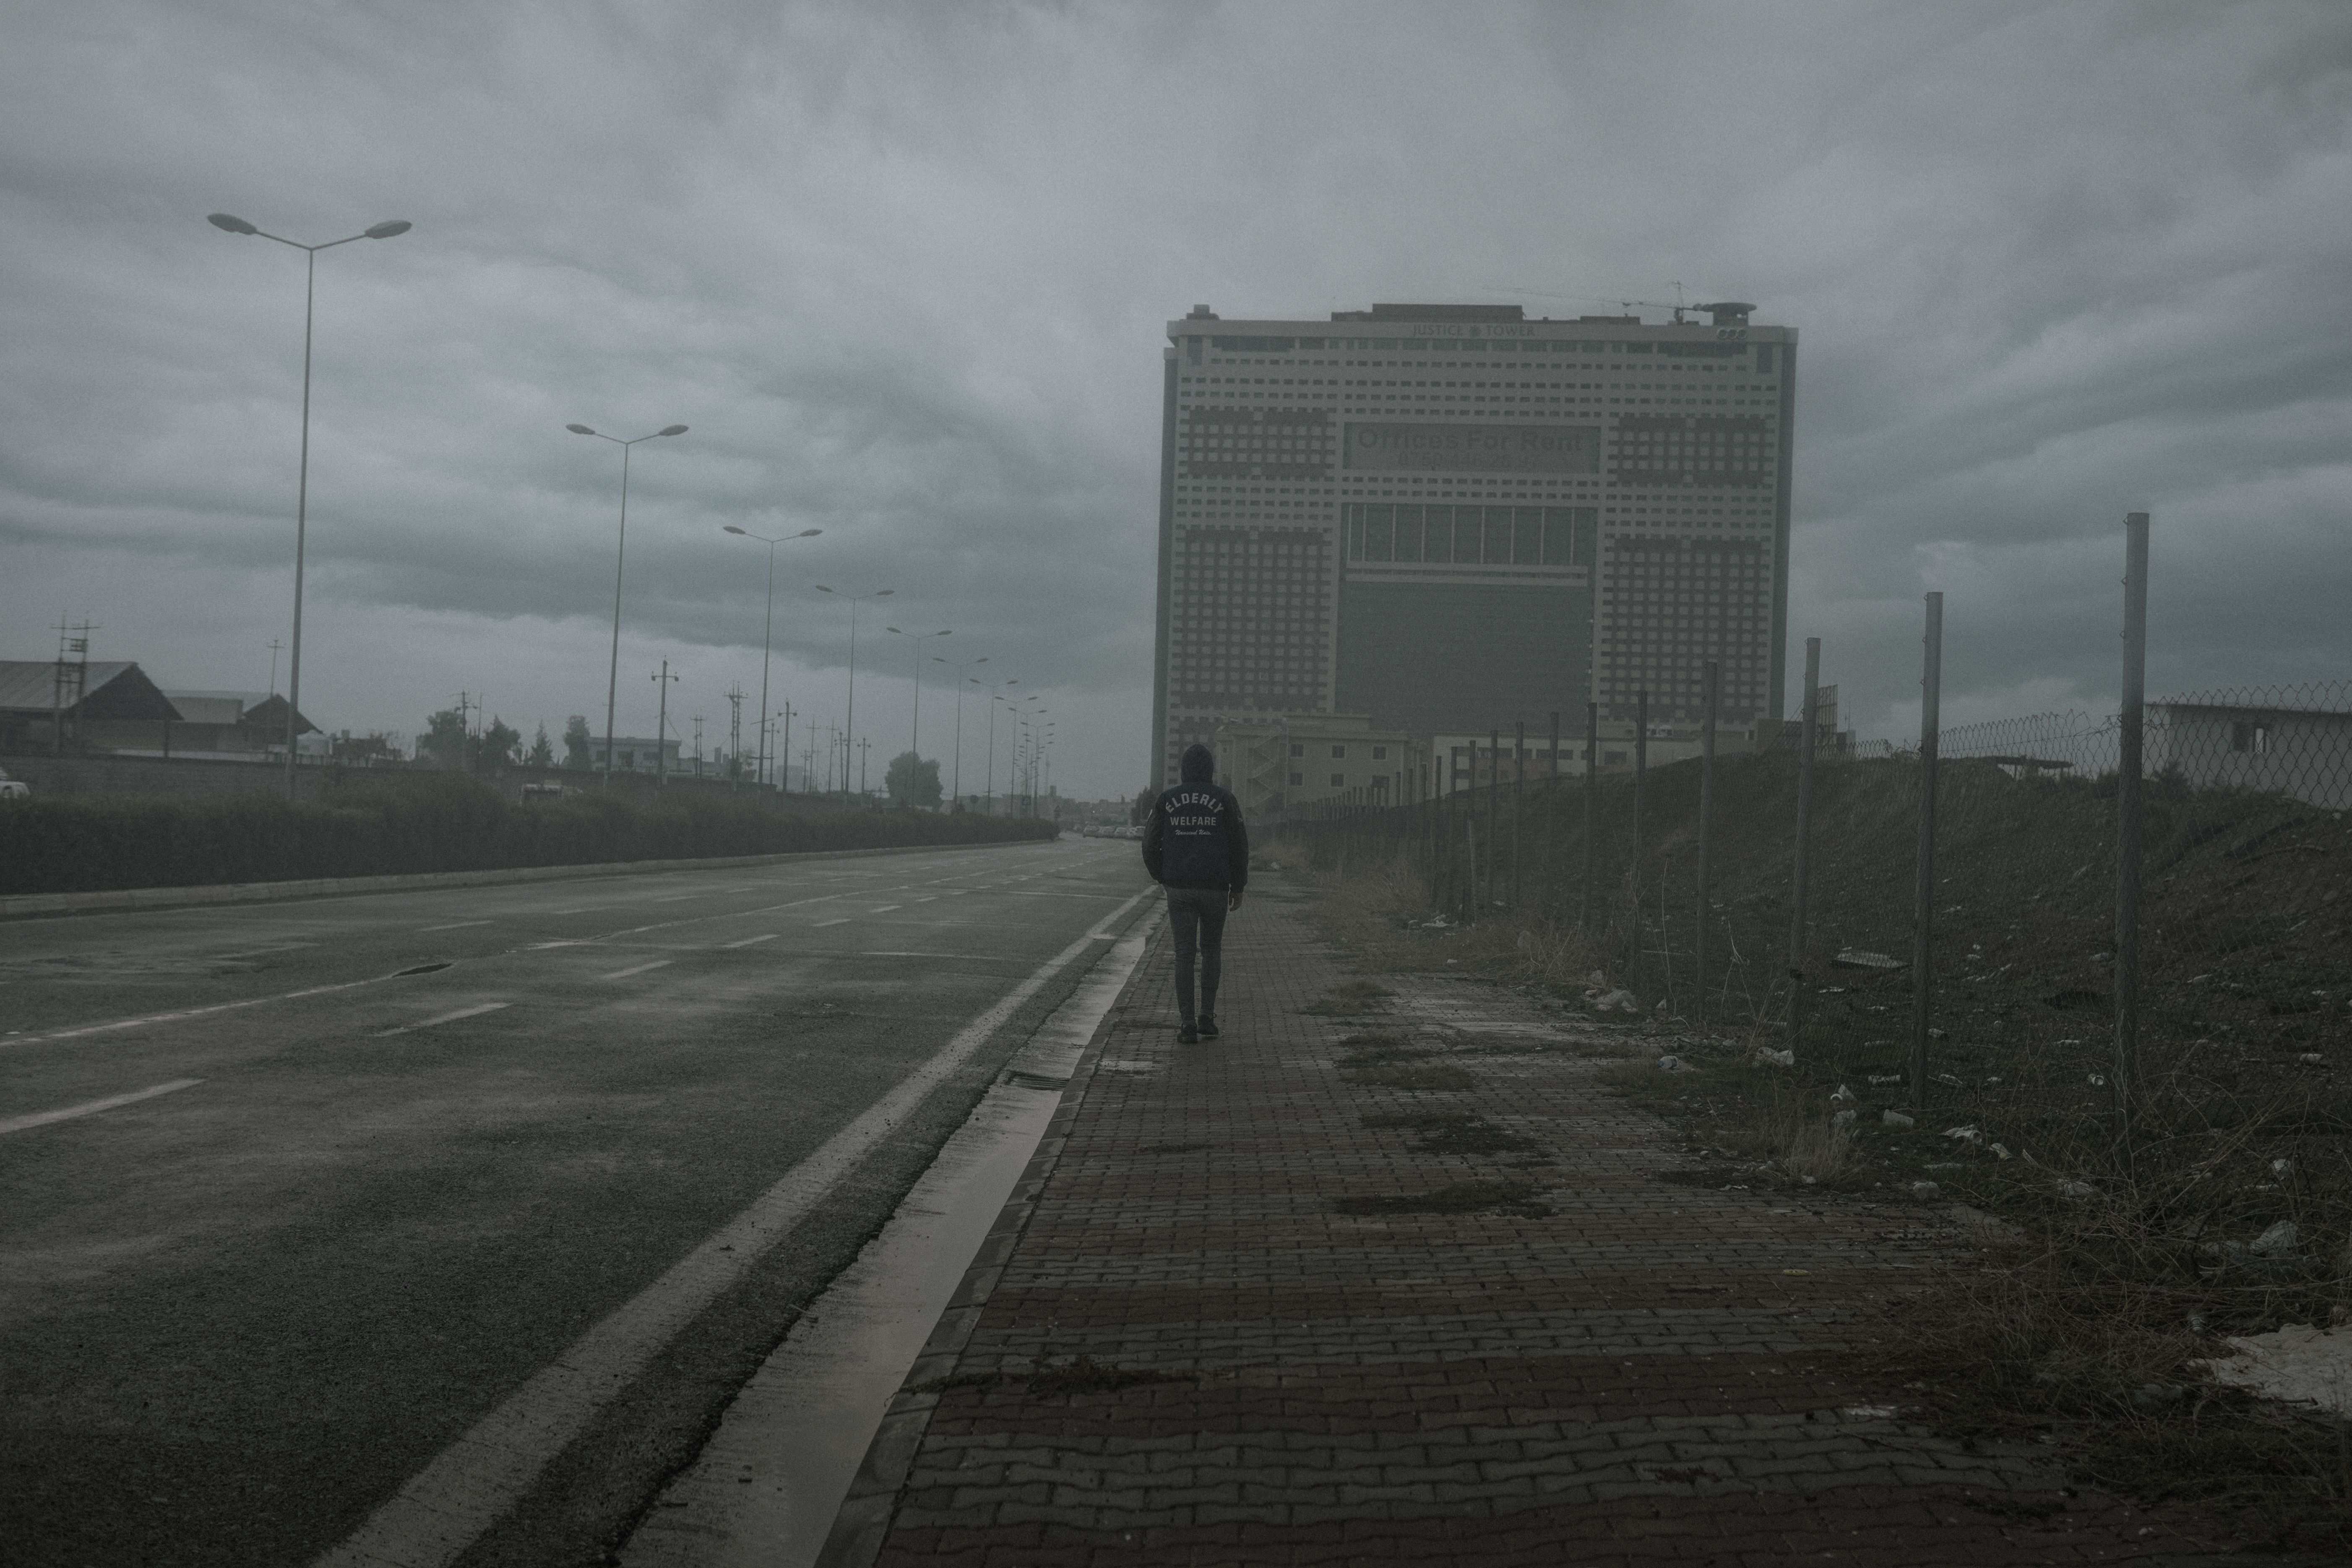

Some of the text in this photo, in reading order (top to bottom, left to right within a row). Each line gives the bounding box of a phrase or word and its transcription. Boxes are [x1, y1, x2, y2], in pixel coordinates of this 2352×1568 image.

[1412, 324, 1535, 338] JUSTICE TOWER
[1359, 428, 1582, 451] Offices For Rent
[1165, 792, 1224, 814] ELDERLY
[1170, 816, 1216, 826] WELFARE
